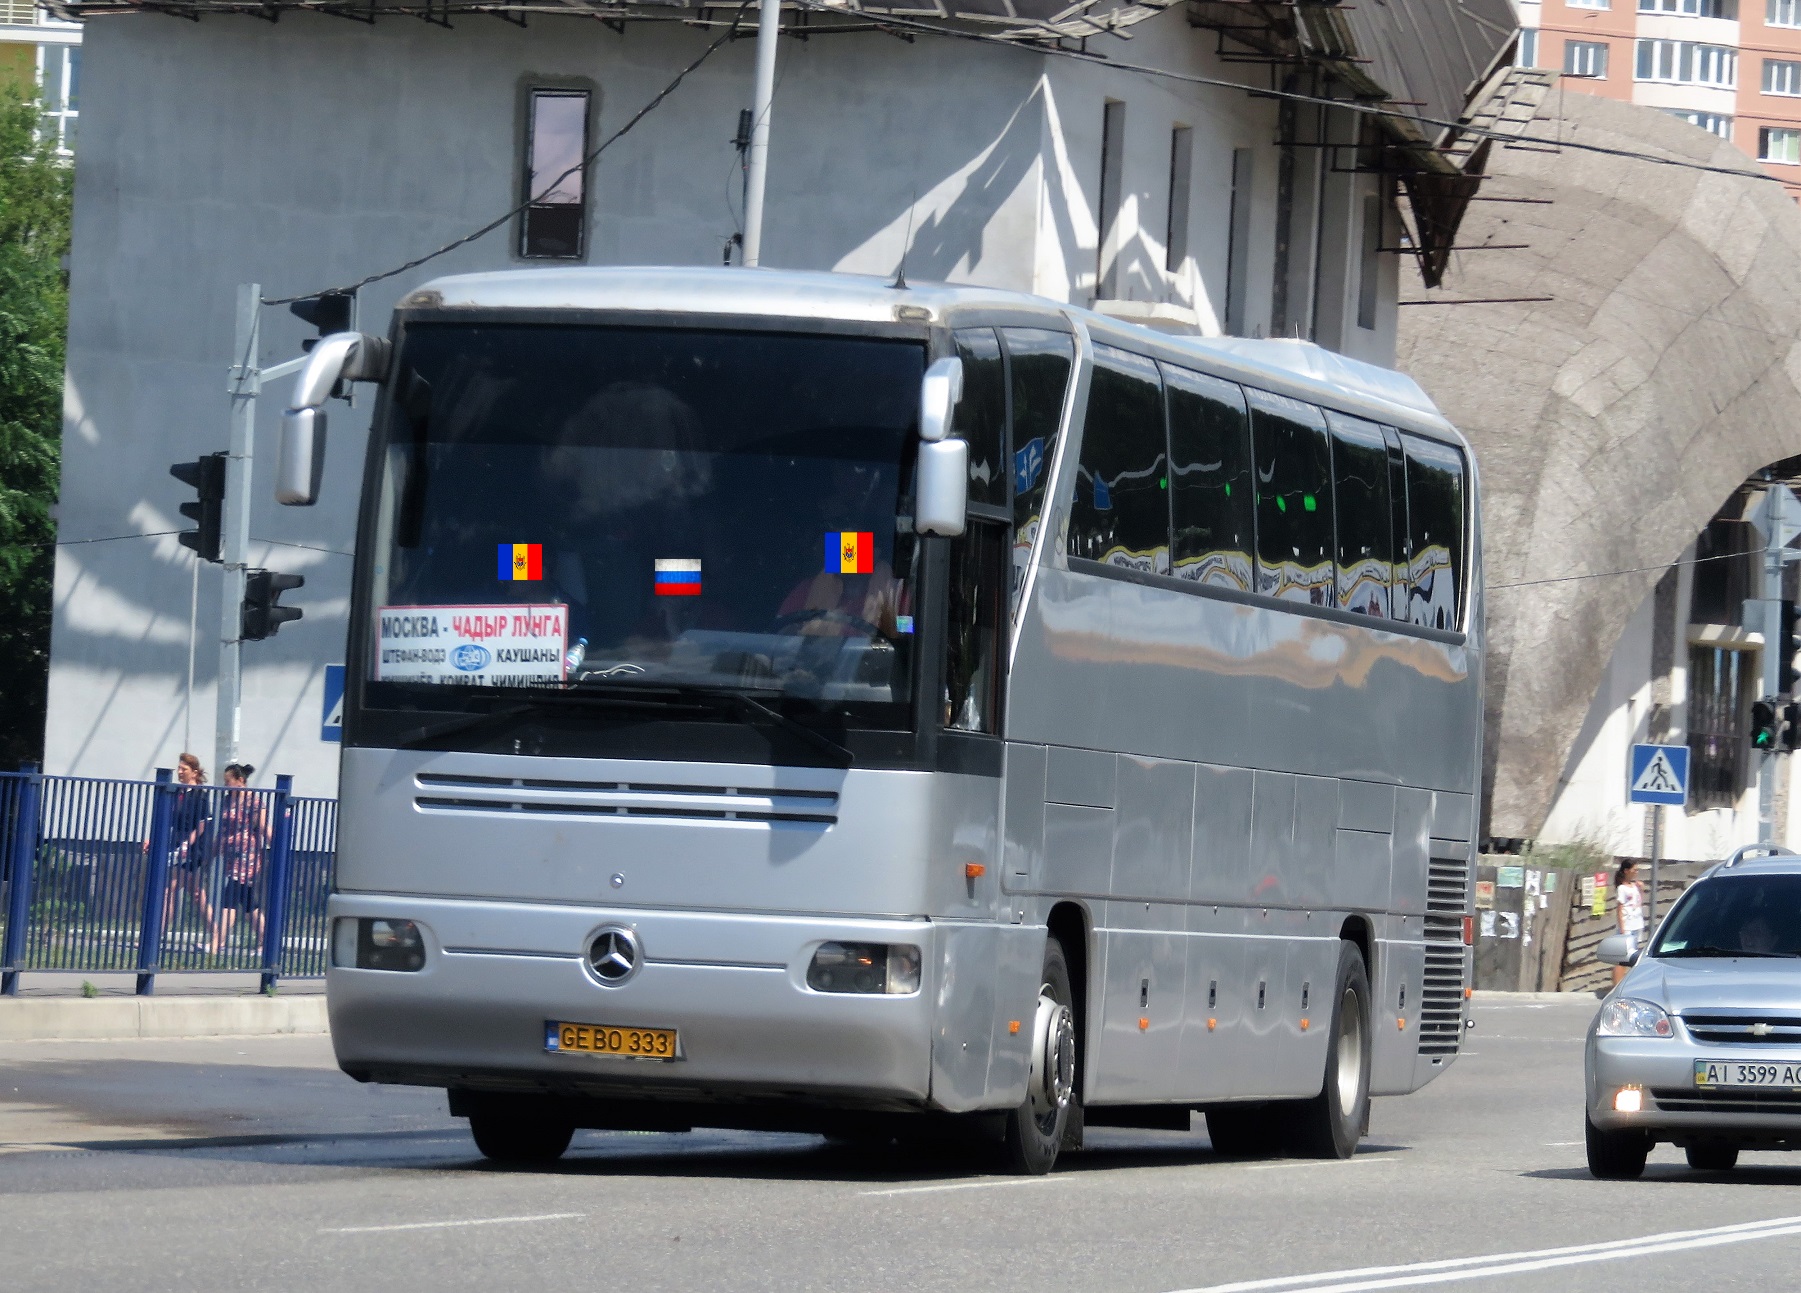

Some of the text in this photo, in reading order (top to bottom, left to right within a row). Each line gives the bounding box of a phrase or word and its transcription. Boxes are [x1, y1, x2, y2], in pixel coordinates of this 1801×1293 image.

[382, 616, 439, 638] МОСКВА
[453, 615, 507, 641] ЧАДЫР
[511, 615, 561, 638] ЛУНГА
[497, 649, 560, 663] КАУШАНЫ
[630, 1032, 668, 1054] 333
[1707, 1065, 1727, 1082] AI
[1737, 1066, 1777, 1083] 3599
